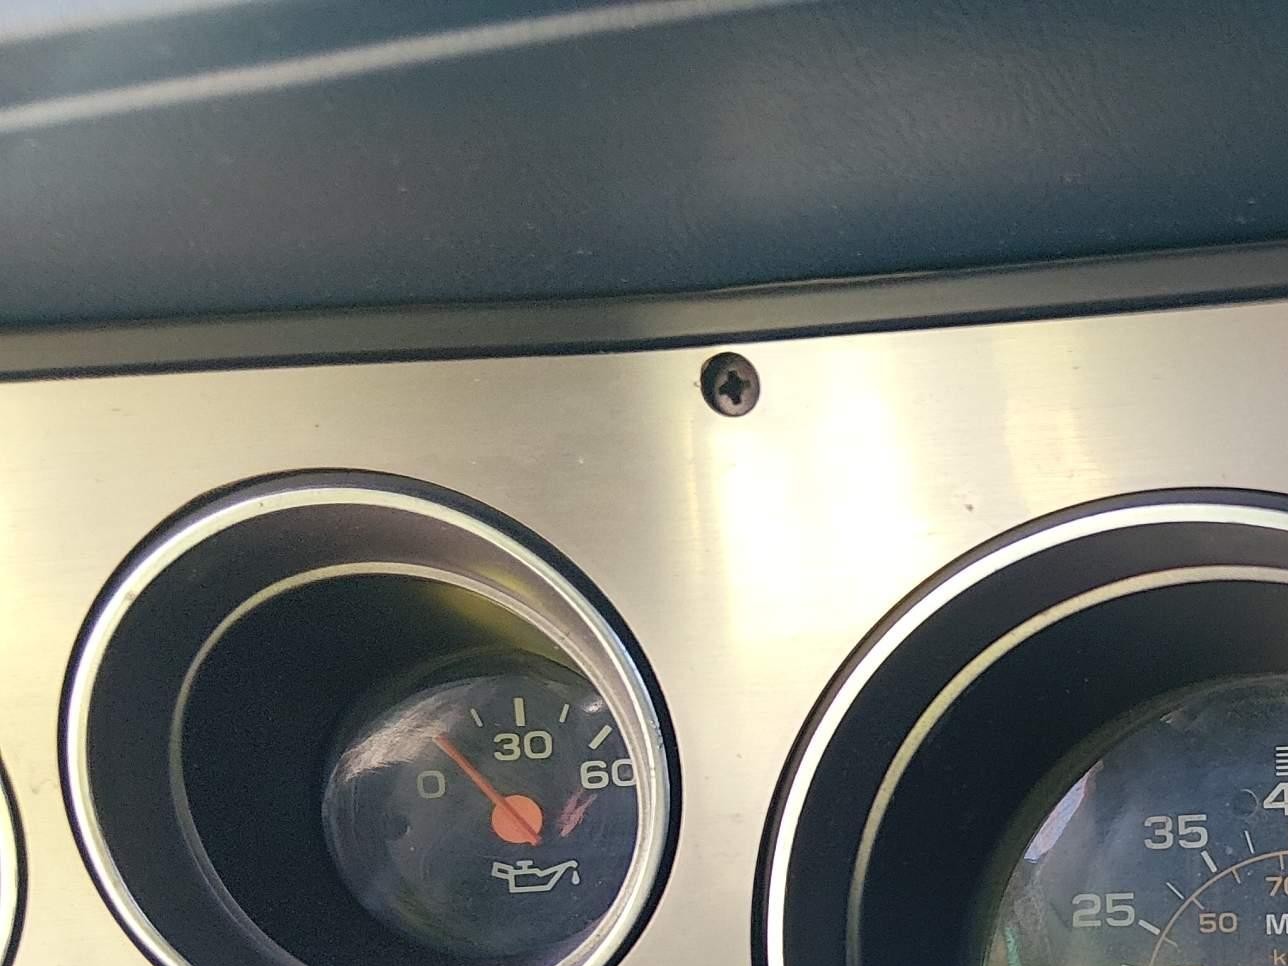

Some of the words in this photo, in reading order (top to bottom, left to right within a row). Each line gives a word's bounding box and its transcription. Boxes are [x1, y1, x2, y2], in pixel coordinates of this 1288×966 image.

[493, 730, 553, 761] 30
[417, 769, 446, 798] 0
[580, 758, 637, 790] 60
[1143, 813, 1209, 850] 35
[1072, 892, 1136, 928] 25
[1199, 912, 1238, 935] 50
